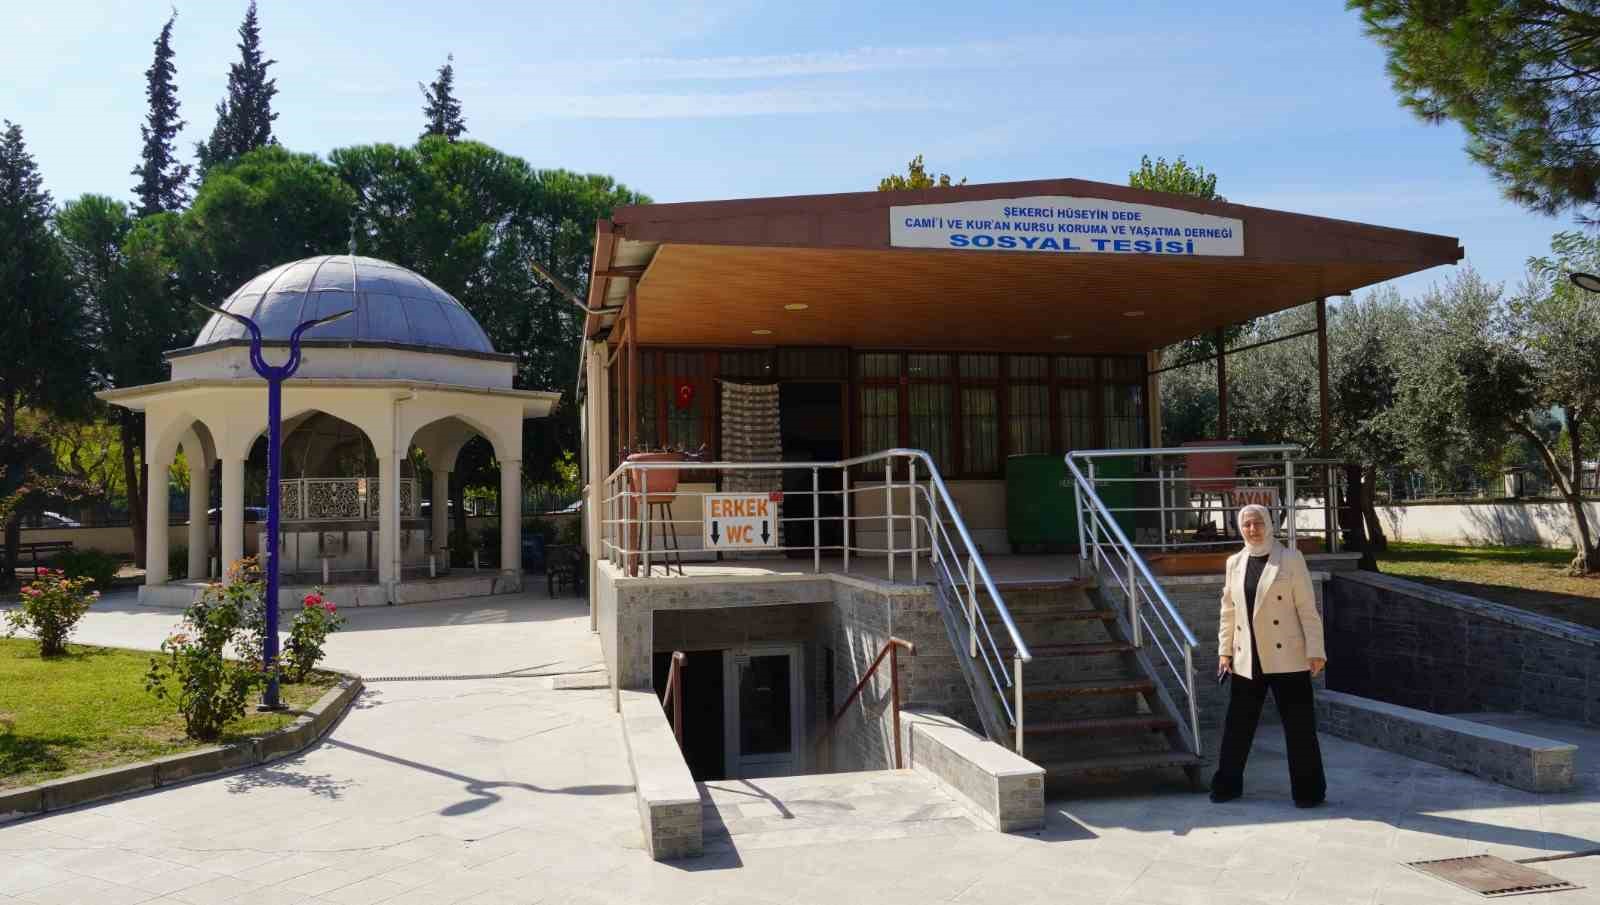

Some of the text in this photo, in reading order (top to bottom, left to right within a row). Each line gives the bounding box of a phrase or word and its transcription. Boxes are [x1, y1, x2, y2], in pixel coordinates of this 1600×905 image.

[1003, 206, 1142, 221] ŞEKERCİ HÜSEYİN DEDE
[947, 219, 963, 229] VE
[1014, 221, 1055, 233] KURSU
[1058, 223, 1108, 234] KORUMA
[1111, 225, 1126, 235] VE
[1129, 225, 1181, 238] YAŞATMA
[1185, 227, 1233, 239] DERNEĞİ
[949, 234, 1194, 254] SOSYAL TESİSİ
[711, 499, 769, 517] ERKEK
[726, 525, 753, 544] WC
